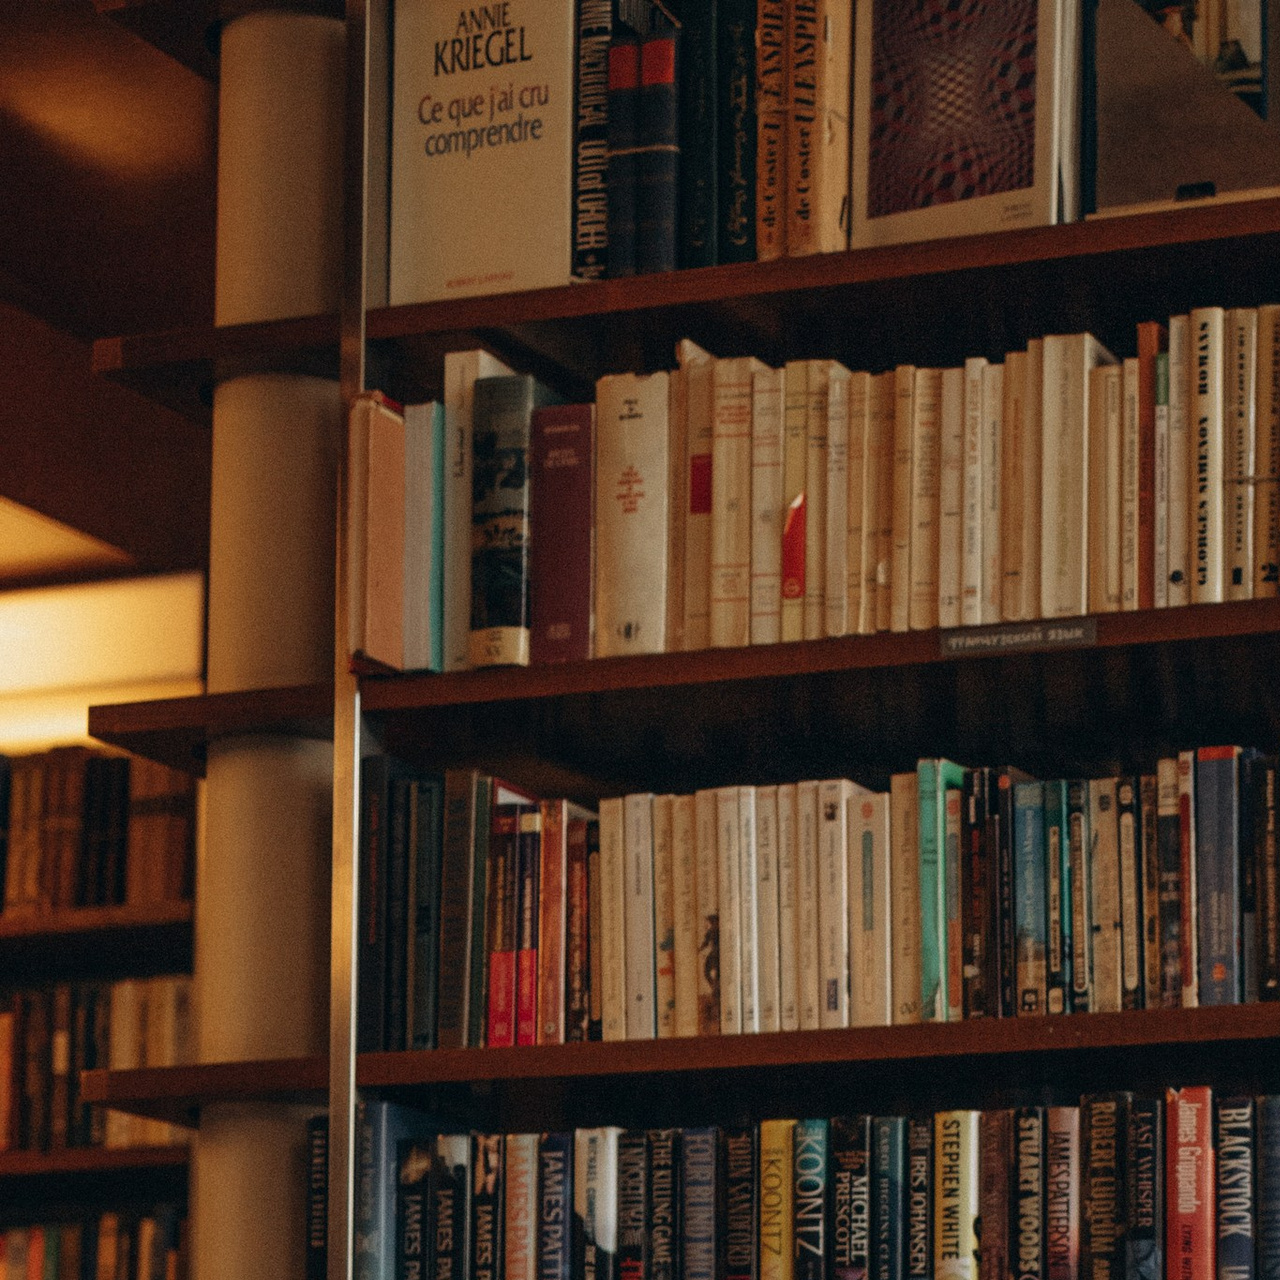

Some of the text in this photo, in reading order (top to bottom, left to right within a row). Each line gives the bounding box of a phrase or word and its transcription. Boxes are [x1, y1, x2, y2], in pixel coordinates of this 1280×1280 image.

[433, 27, 532, 77] KRIEGEL
[456, 3, 510, 32] ANNIE
[418, 82, 550, 125] Ce que j'ai cru
[424, 115, 542, 159] comprendre
[762, 138, 778, 228] de Coster
[796, 128, 810, 220] de Coster
[1197, 322, 1209, 586] GEORGES SIMENON ROMANS
[509, 1142, 531, 1226] JAMES
[541, 1149, 565, 1224] JAMES
[586, 1135, 599, 1184] MICHAEL
[620, 1146, 645, 1226] PATTERSON
[685, 1133, 712, 1184] FOUR
[878, 1126, 889, 1173] CAROL
[942, 1119, 960, 1260] STEPHEN WHITE
[1089, 1101, 1116, 1253] ROBERT LUDLUM
[1135, 1111, 1154, 1228] LAST WHISPER
[1175, 1100, 1202, 1214] James Grippando
[1219, 1106, 1253, 1240] BLACKSTOCK
[403, 1194, 422, 1255] JAMES
[435, 1188, 454, 1251] JAMES
[475, 1204, 493, 1265] JAMES
[651, 1139, 672, 1267] THE KILLING GAME
[685, 1187, 711, 1243] BLIND
[727, 1182, 749, 1267] SANDFORD
[761, 1158, 782, 1256] KOONTZ
[795, 1134, 824, 1257] KOONTZ
[834, 1171, 850, 1266] PRESCOTT
[850, 1174, 868, 1262] MICHAEL
[878, 1178, 889, 1239] HIGGINS
[908, 1155, 926, 1275] IRIS JOHANSEN
[1017, 1117, 1040, 1273] STUART WOODS
[1048, 1131, 1070, 1267] JAMES PATTERSON
[1179, 1224, 1192, 1253] LYING
